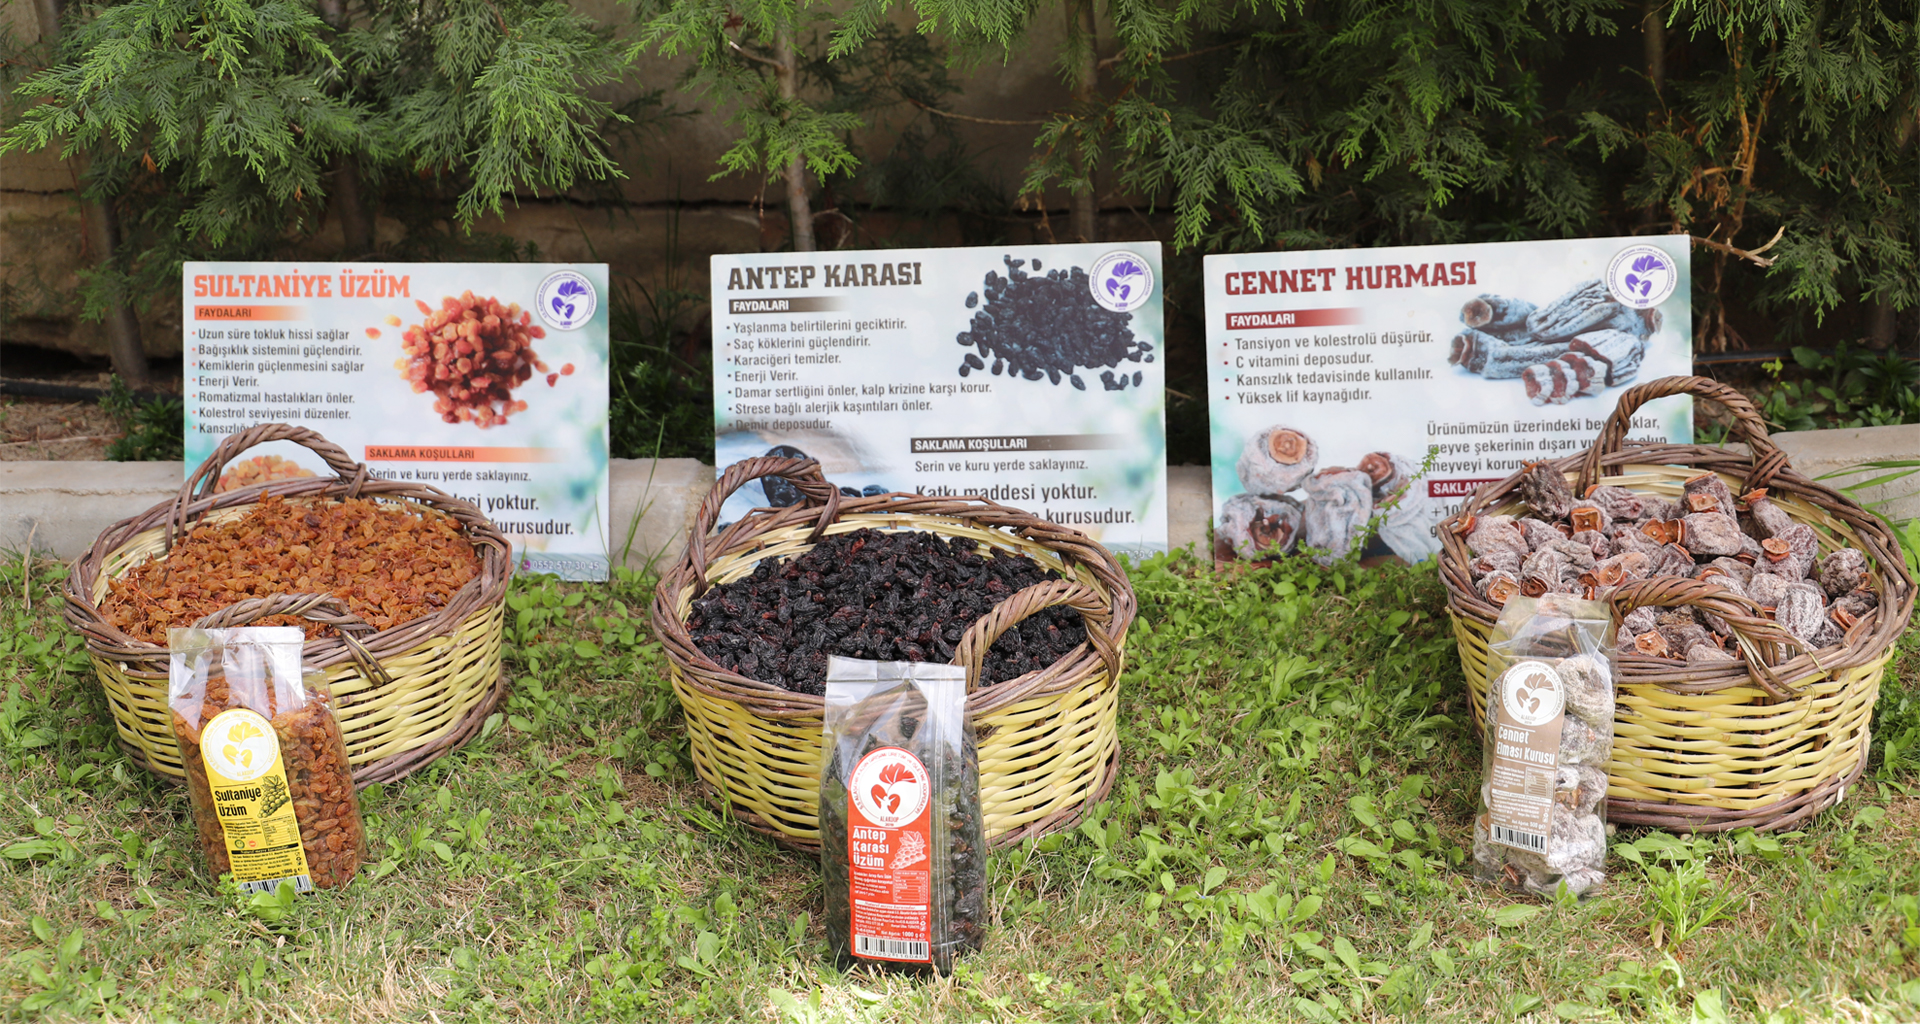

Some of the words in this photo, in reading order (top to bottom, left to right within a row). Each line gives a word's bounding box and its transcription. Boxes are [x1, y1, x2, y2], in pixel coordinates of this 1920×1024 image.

[194, 269, 332, 297] SULTANİYE
[340, 268, 410, 297] ÜZÜM
[728, 266, 815, 290] ANTEP
[824, 262, 921, 287] KARASI
[1225, 268, 1336, 295] CENNET
[1345, 261, 1476, 290] HURMASI
[199, 308, 251, 317] FAYDALARI
[733, 300, 788, 311] FAYDALARI
[733, 322, 786, 335] Yaşlanma
[791, 320, 851, 332] belirtilerini
[855, 318, 907, 332] geciktirir.
[1231, 314, 1295, 326] FAYDALARI
[198, 329, 224, 339] Uzun
[228, 329, 250, 340] süre
[254, 329, 285, 340] tokluk
[289, 329, 312, 340] hissi
[317, 329, 350, 342] sağlar
[734, 338, 754, 351] Saç
[758, 337, 804, 349] köklerini
[809, 335, 870, 350] güçlendirir.
[1235, 336, 1290, 351] Tansiyon
[1295, 338, 1309, 348] ve
[1314, 333, 1376, 347] kolestrolü
[1382, 331, 1433, 347] düşürür.
[199, 345, 249, 357] Bağışıklık
[252, 345, 300, 355] sistemini
[303, 345, 362, 358] güçlendirir.
[199, 360, 254, 371] Kemiklerin
[258, 361, 328, 373] güçlenmesini
[332, 361, 364, 373] sağlar
[734, 354, 791, 366] Karaciğeri
[795, 353, 841, 365] temizler.
[1236, 356, 1243, 369] C
[1249, 354, 1299, 369] vitamini
[1304, 352, 1373, 368] deposudur.
[199, 376, 229, 388] Enerji
[232, 376, 259, 386] Verir.
[735, 370, 766, 383] Enerji
[770, 369, 798, 381] Verir.
[1237, 373, 1293, 386] Kansızlık
[1297, 370, 1370, 384] tedavisinde
[1375, 367, 1433, 381] kullanılır.
[199, 392, 261, 402] Romatizmal
[264, 392, 322, 403] hastalıkları
[326, 392, 354, 403] önler.
[735, 386, 771, 398] Damar
[775, 385, 824, 399] sertliğini
[828, 384, 858, 397] önler,
[862, 384, 885, 397] kalp
[888, 383, 925, 395] krizine
[929, 383, 956, 396] karşı
[960, 382, 992, 393] korur.
[1238, 391, 1282, 404] Yüksek
[1287, 390, 1298, 402] lif
[1303, 388, 1372, 404] kaynağıdır.
[199, 408, 245, 418] Kolestrol
[249, 408, 300, 420] seviyesini
[305, 408, 350, 419] düzenler.
[735, 403, 771, 414] Strese
[775, 402, 801, 415] bağlı
[805, 401, 840, 415] alerjik
[843, 401, 899, 415] kaşıntıları
[902, 400, 932, 412] önler.
[736, 419, 769, 430] Demir
[773, 418, 832, 431] deposudur.
[1427, 420, 1509, 436] Ürünümüzün
[1514, 419, 1580, 433] üzerindeki
[915, 440, 965, 451] SAKLAMA
[968, 438, 1027, 451] KOŞULLARI
[1428, 441, 1469, 455] meyve
[1475, 438, 1534, 456] şekerinin
[1539, 436, 1575, 452] dışarı
[370, 449, 416, 458] SAKLAMA
[420, 450, 474, 461] KOŞULLARI
[915, 460, 944, 472] Serin
[949, 462, 961, 471] ve
[965, 460, 989, 471] kuru
[993, 460, 1025, 473] yerde
[1029, 459, 1088, 473] saklayınız.
[1428, 458, 1482, 473] meyveyi
[369, 468, 396, 480] Serin
[400, 470, 412, 480] ve
[416, 470, 438, 480] kuru
[443, 470, 472, 482] yerde
[476, 470, 531, 483] saklayınız.
[964, 484, 1035, 500] maddesi
[1042, 484, 1097, 503] yoktur.
[488, 495, 539, 512] yoktur.
[1046, 508, 1135, 524] kurusudur.
[1498, 726, 1530, 744] Cennet
[1496, 742, 1522, 759] Elması
[1524, 748, 1555, 765] Kurusu
[215, 787, 261, 801] Sultaniye
[218, 804, 247, 816] Üzüm
[853, 828, 886, 843] Antep
[853, 841, 889, 854] Karası
[853, 852, 884, 867] Üzüm
